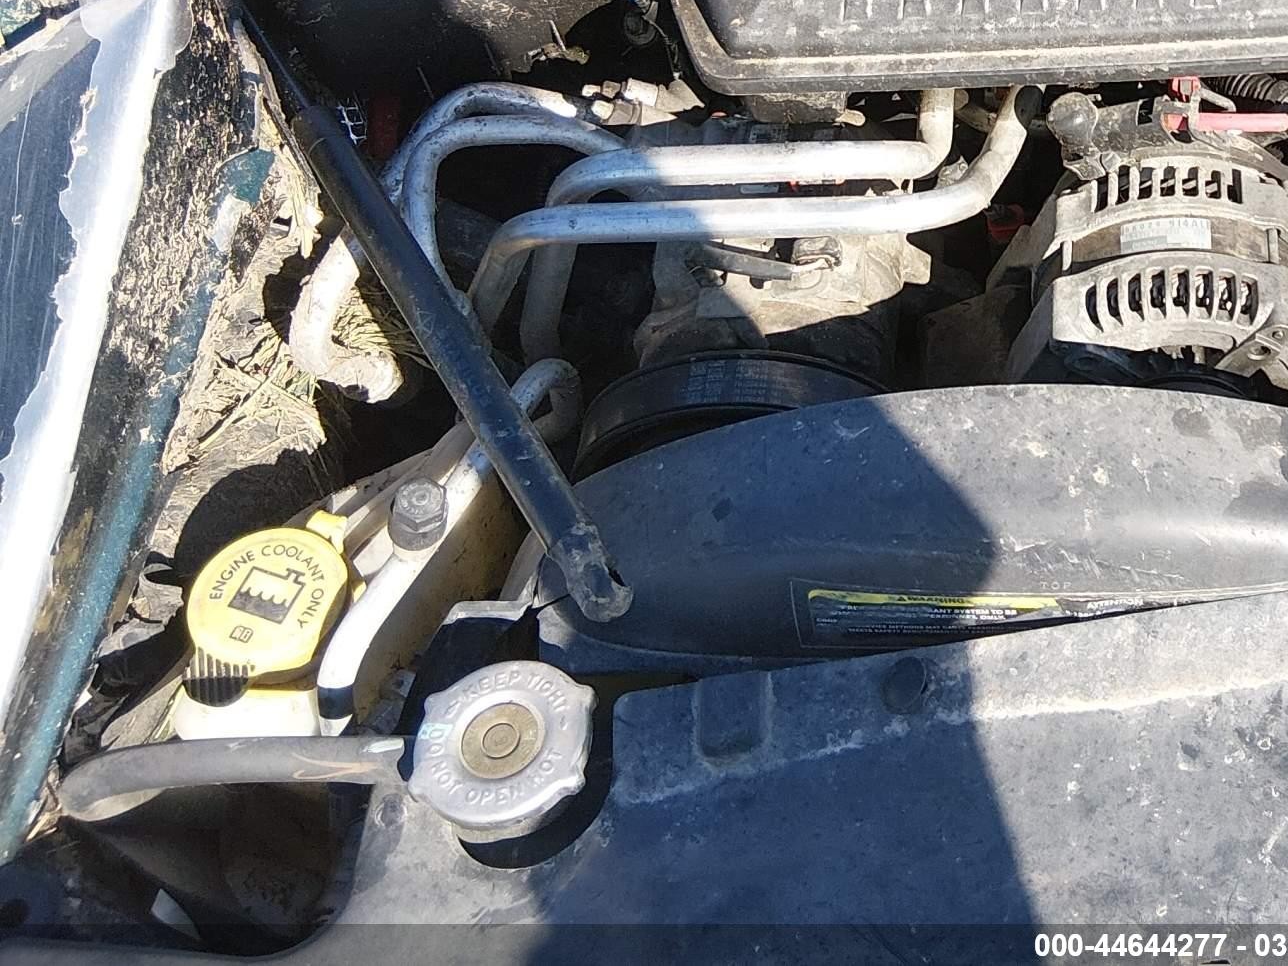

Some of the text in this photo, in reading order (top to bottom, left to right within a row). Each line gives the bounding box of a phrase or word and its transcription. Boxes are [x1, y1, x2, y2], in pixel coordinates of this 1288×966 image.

[209, 544, 325, 628] ENGINE COOLANT ONLY
[1040, 581, 1072, 590] TOP
[461, 670, 570, 713] KEEP TIGHT
[428, 727, 446, 758] DO
[430, 760, 463, 795] NOT
[464, 787, 526, 806] OPEN
